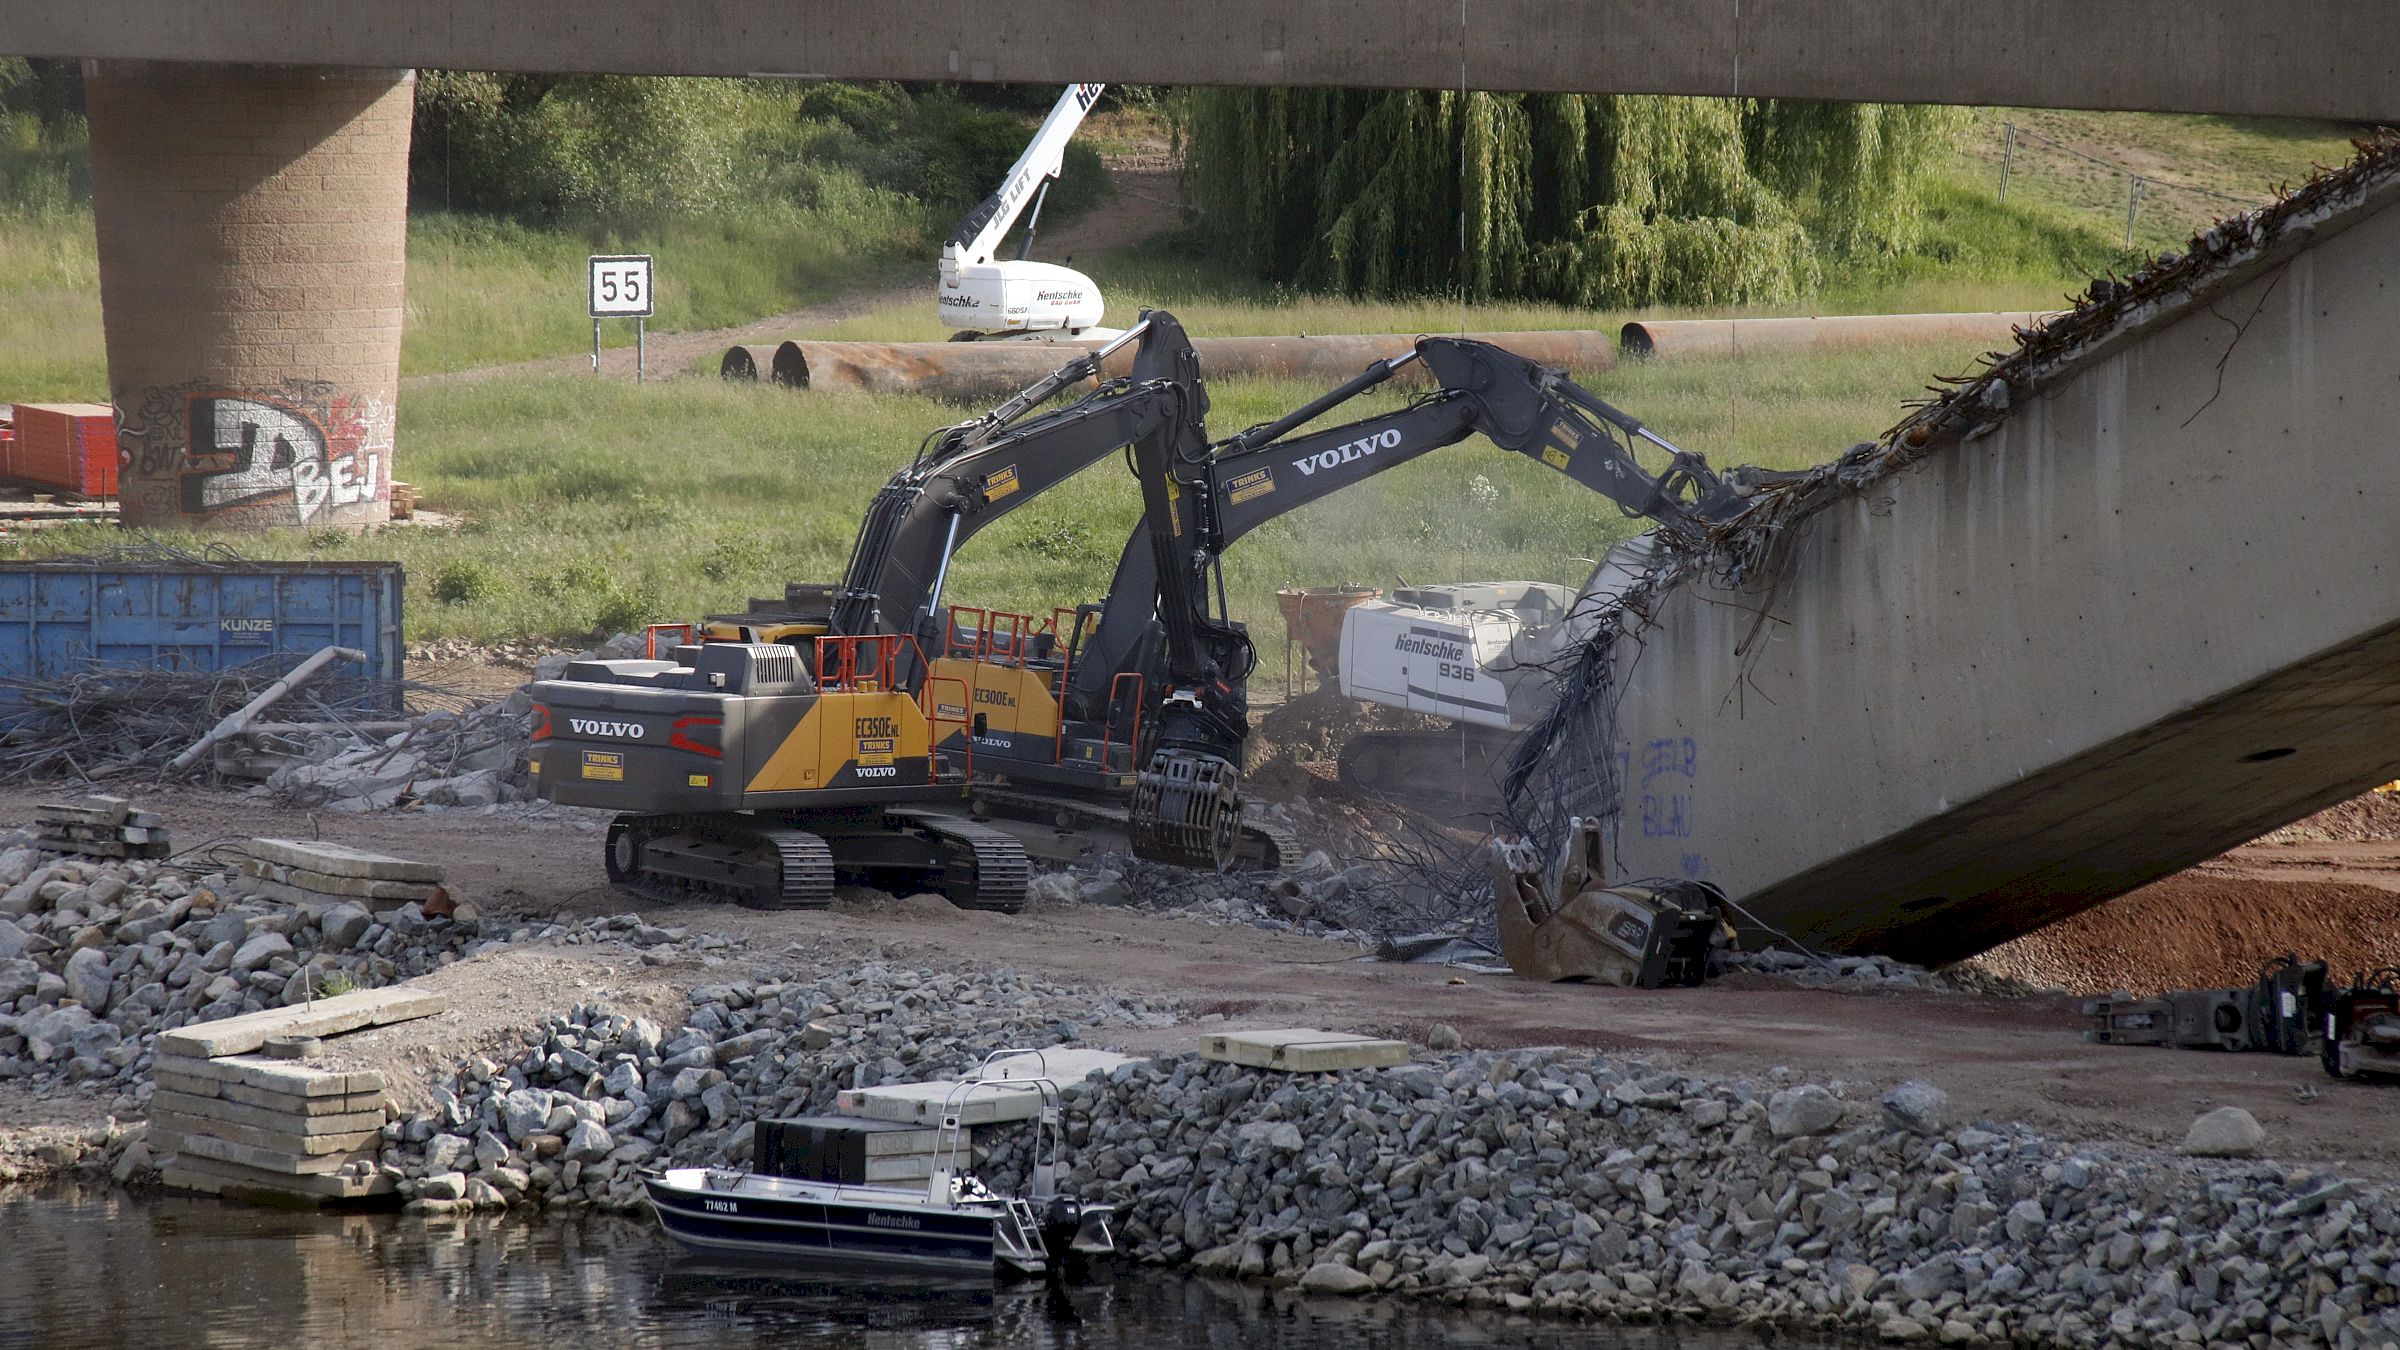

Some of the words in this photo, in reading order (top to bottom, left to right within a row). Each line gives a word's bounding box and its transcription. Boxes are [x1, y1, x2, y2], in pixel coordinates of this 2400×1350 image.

[993, 200, 1011, 230] JLG
[1009, 167, 1032, 204] LIFT
[602, 271, 639, 302] 55
[1292, 428, 1402, 476] VOLVO
[987, 468, 1013, 487] TRINKS
[1231, 469, 1267, 489] TRINKS
[221, 619, 272, 632] KUNZE
[1439, 662, 1475, 682] 936
[569, 718, 645, 739] VOLVO
[863, 741, 890, 750] TRINKS
[587, 753, 618, 764] TRINKS
[855, 766, 897, 778] VOLVO
[729, 1202, 738, 1213] M
